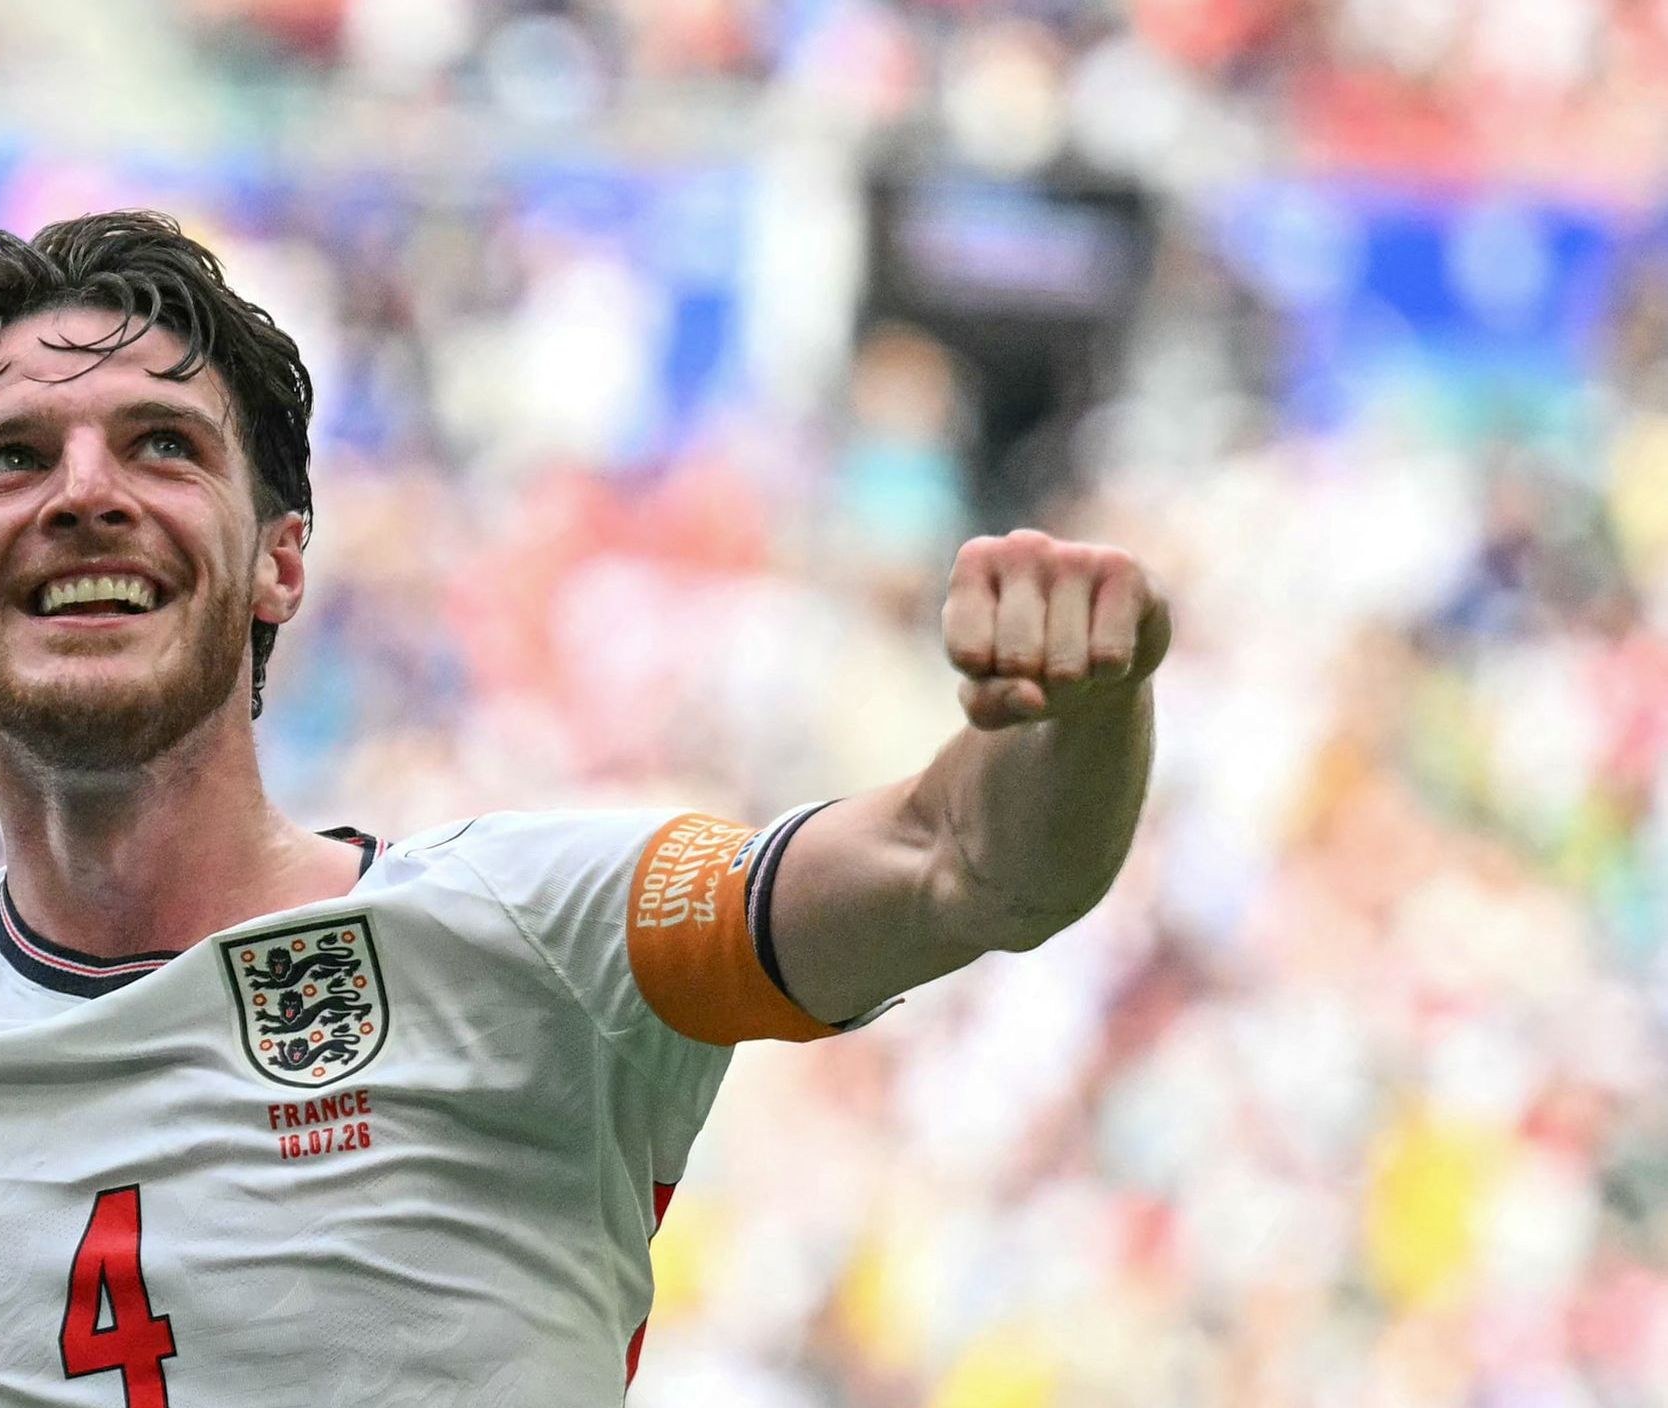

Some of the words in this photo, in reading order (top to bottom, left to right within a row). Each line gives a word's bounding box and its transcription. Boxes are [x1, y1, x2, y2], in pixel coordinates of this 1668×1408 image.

[636, 818, 717, 928] FOOTBALL
[692, 869, 718, 931] the
[268, 1089, 372, 1130] FRANCE
[279, 1121, 370, 1160] 18.07.26
